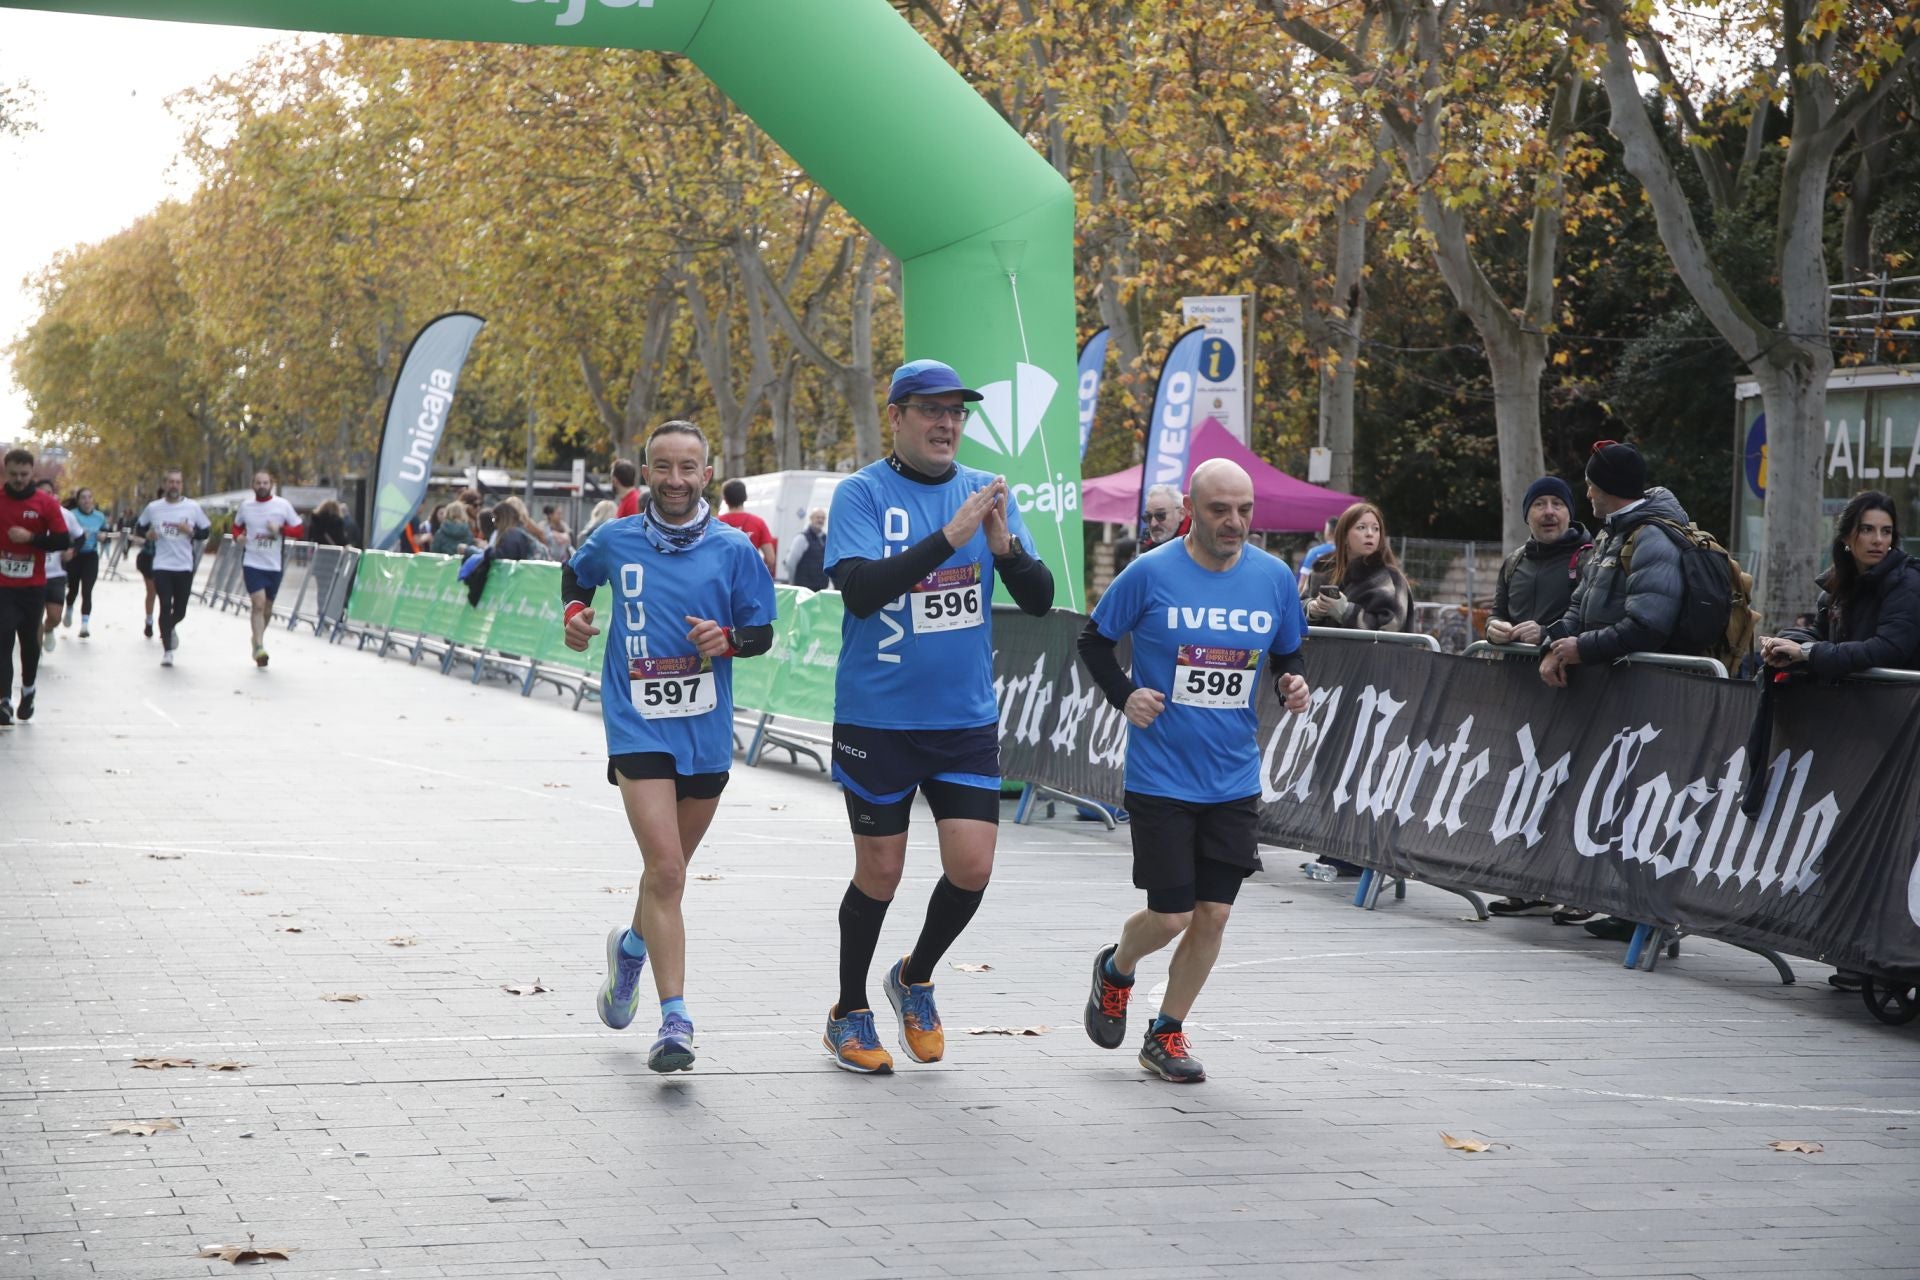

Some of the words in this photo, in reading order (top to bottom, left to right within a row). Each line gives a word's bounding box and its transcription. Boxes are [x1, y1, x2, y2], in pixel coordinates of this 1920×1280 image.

[399, 368, 453, 482] Unicaja
[998, 472, 1077, 523] caja
[924, 589, 978, 620] 596
[1167, 606, 1272, 634] IVECO
[644, 678, 701, 706] 597
[1186, 670, 1243, 697] 598
[992, 652, 1053, 747] rte
[837, 741, 867, 759] IVECO
[1260, 685, 1343, 804] El
[1333, 684, 1490, 837] Norte
[1489, 722, 1571, 849] de
